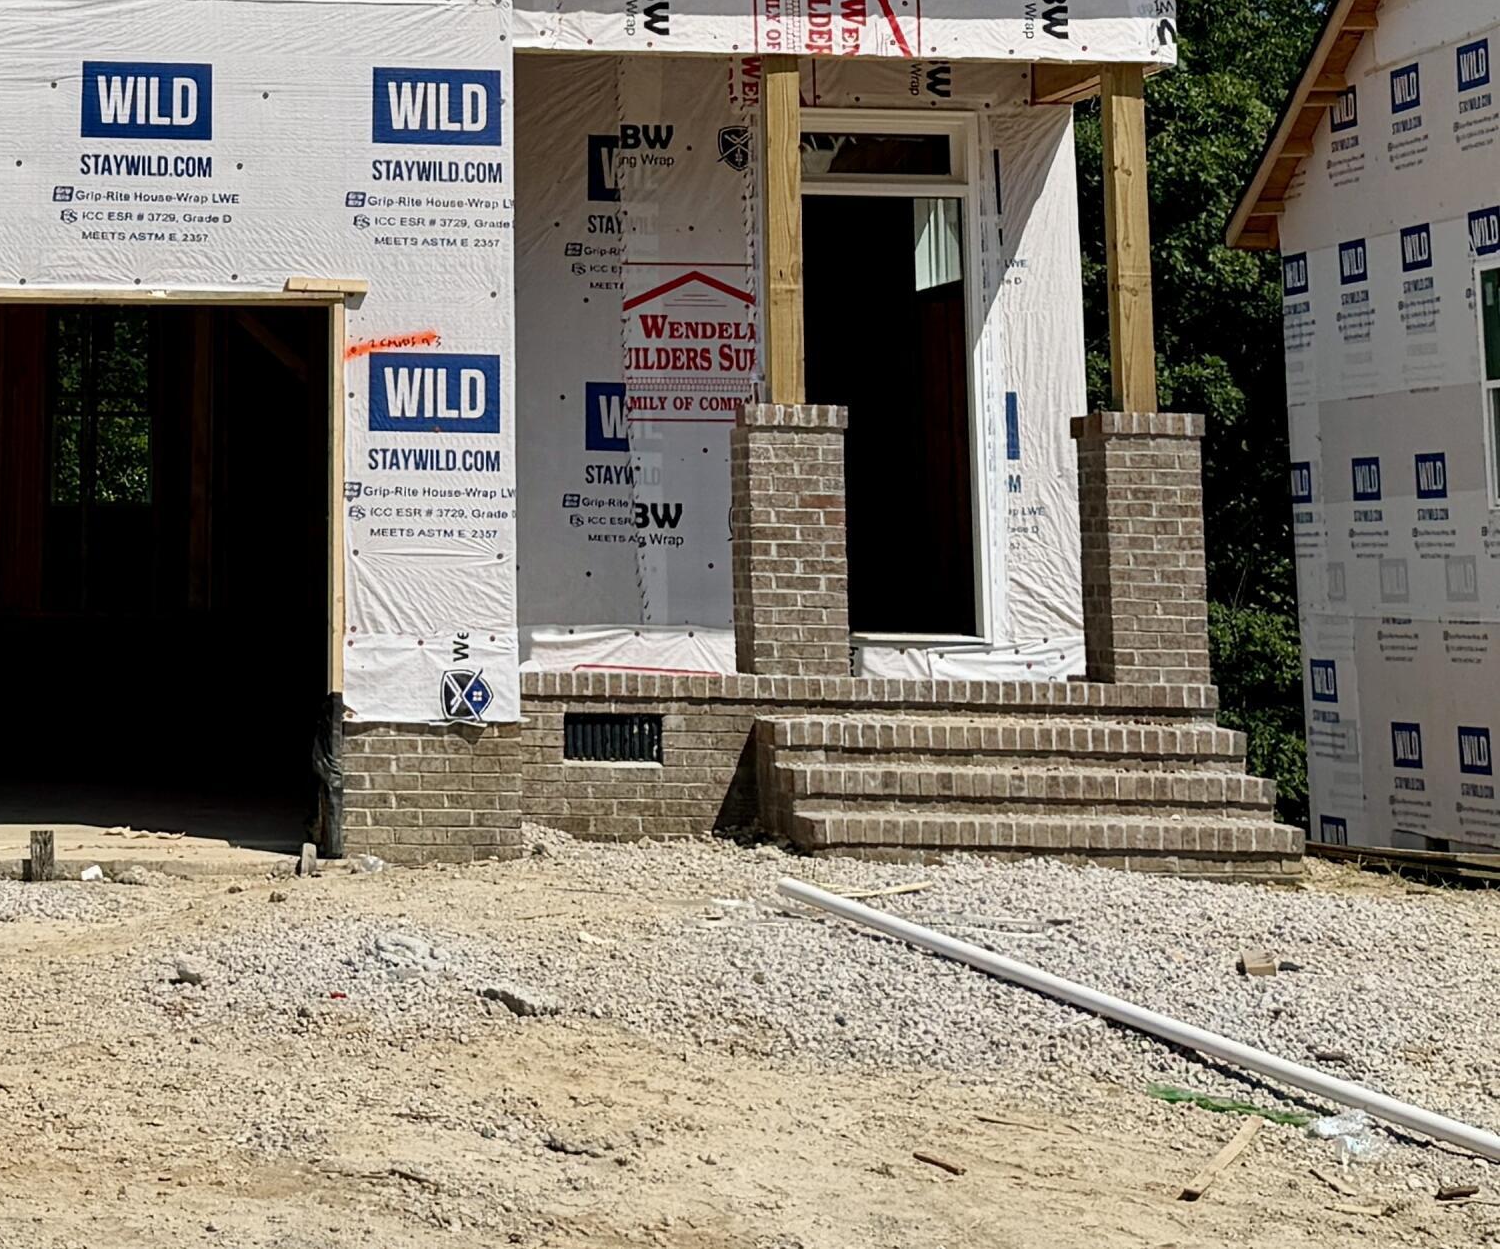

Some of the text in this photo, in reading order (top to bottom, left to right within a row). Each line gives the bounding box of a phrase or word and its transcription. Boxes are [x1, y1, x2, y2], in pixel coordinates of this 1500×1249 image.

[624, 0, 638, 36] Wrap
[1022, 3, 1037, 39] Wrap
[766, 29, 780, 51] OF
[1460, 47, 1486, 83] WILD
[97, 75, 197, 125] WILD
[1393, 71, 1417, 105] WILD
[388, 82, 486, 131] WILD
[620, 125, 674, 149] BW
[80, 154, 212, 178] STAYWILD.COM
[372, 160, 502, 183] STAYWILD.COM
[642, 155, 674, 167] Wrap
[76, 190, 239, 204] Grip-Rite House-Wrap LWE
[82, 211, 103, 220] ICC
[108, 212, 132, 221] ESR
[183, 213, 219, 223] Grade
[223, 215, 232, 223] D
[1471, 215, 1499, 249] WILD
[82, 231, 125, 240] MEETS
[129, 232, 165, 241] ASTM
[169, 233, 176, 241] E
[1404, 231, 1429, 264] WILD
[1285, 259, 1306, 289] WILD
[1342, 246, 1364, 277] WILD
[385, 367, 485, 419] WILD
[673, 397, 694, 411] OF
[368, 449, 500, 472] STAYWILD.COM
[1354, 465, 1378, 493] WILD
[1418, 461, 1444, 491] WILD
[650, 534, 684, 548] Wrap
[1312, 667, 1334, 695] WILD
[1395, 730, 1419, 761] WILD
[1461, 735, 1488, 767] WILD
